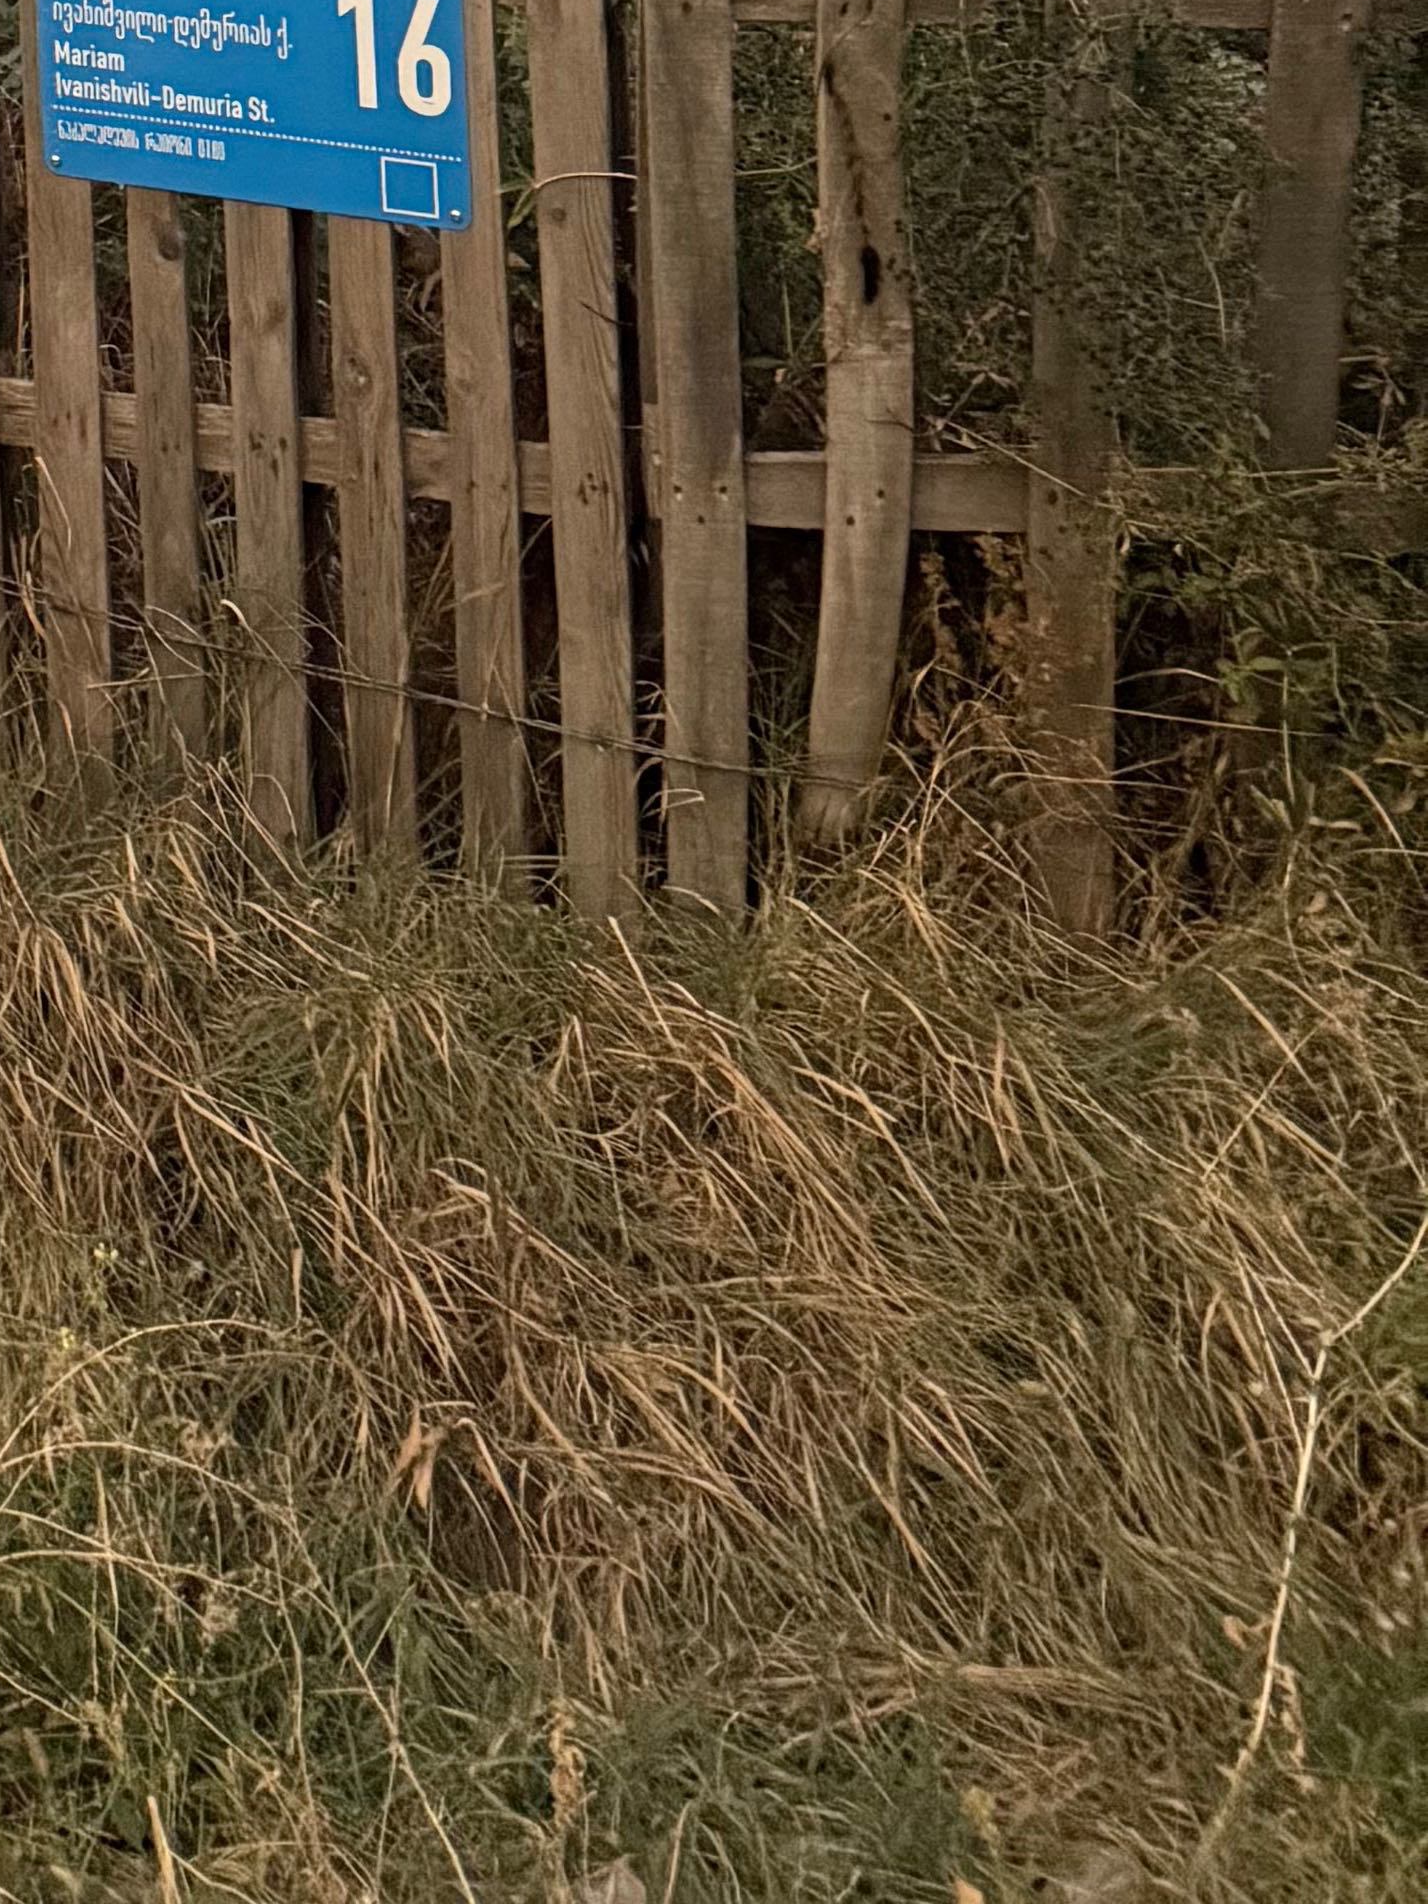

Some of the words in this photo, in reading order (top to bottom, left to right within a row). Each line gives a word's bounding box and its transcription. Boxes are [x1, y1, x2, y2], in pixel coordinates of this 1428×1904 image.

[54, 40, 125, 72] Mariam
[55, 71, 243, 119] Ivanishvili-Demuria
[247, 95, 276, 123] St.
